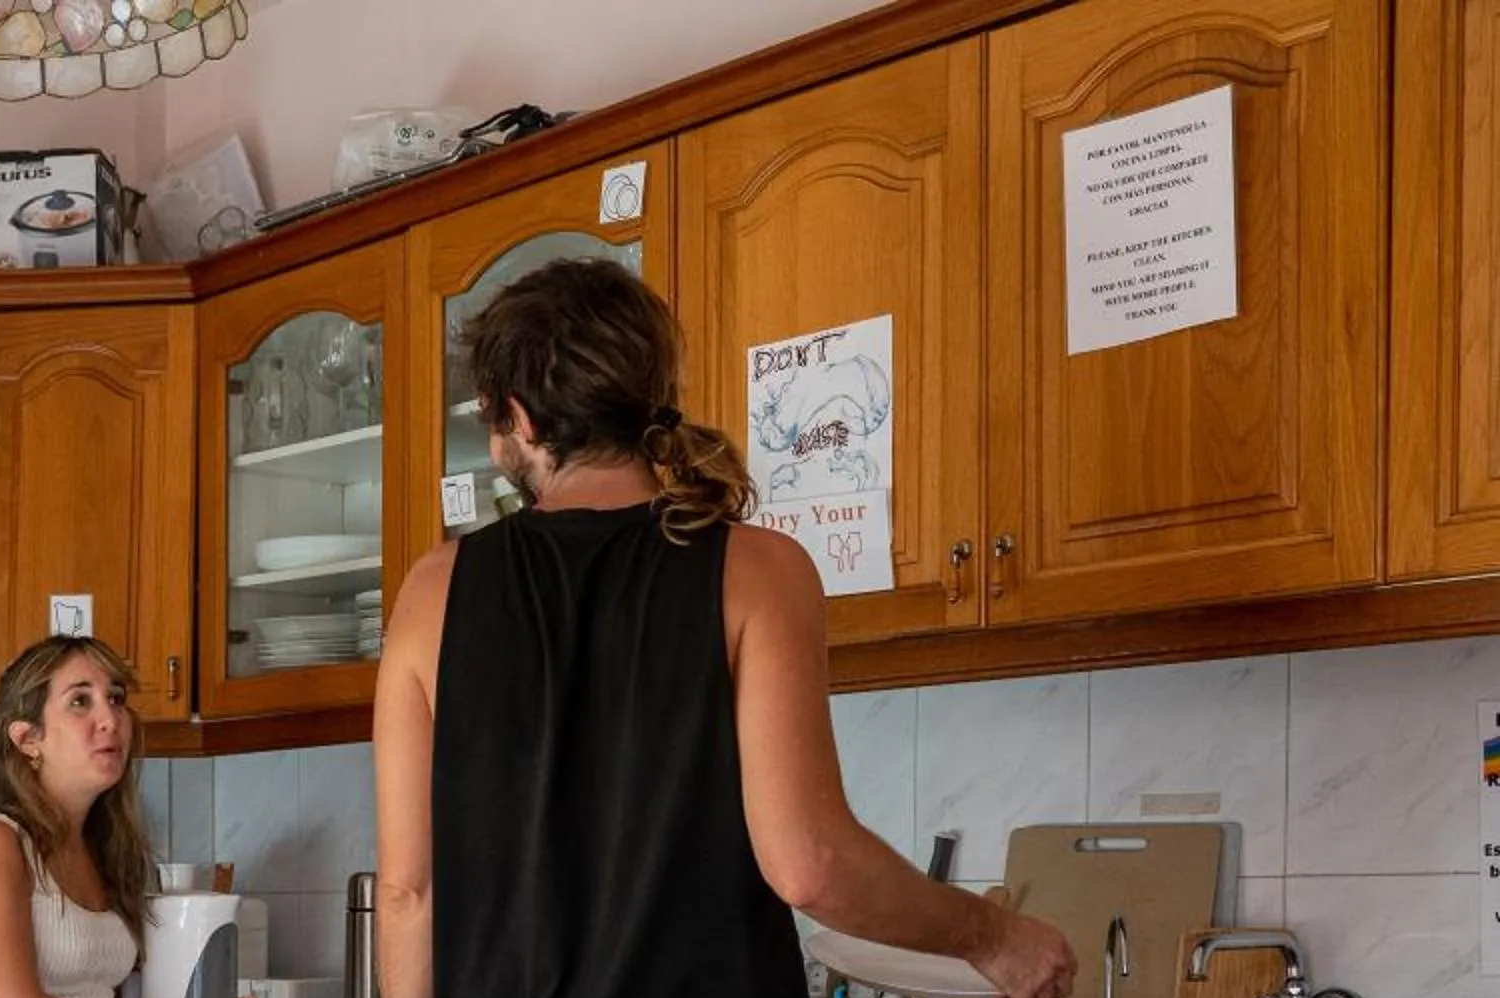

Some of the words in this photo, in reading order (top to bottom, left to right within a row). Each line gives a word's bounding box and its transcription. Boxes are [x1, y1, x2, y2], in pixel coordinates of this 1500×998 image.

[1111, 152, 1147, 169] COCINA
[1125, 240, 1149, 253] KEEP
[1151, 235, 1168, 248] THE
[1171, 225, 1213, 243] KITCHEN
[1139, 272, 1158, 285] ARE
[1105, 295, 1130, 307] WITH
[1131, 287, 1158, 301] MORE
[1125, 307, 1156, 321] THANK
[761, 511, 800, 533] Dry
[811, 503, 867, 525] Your
